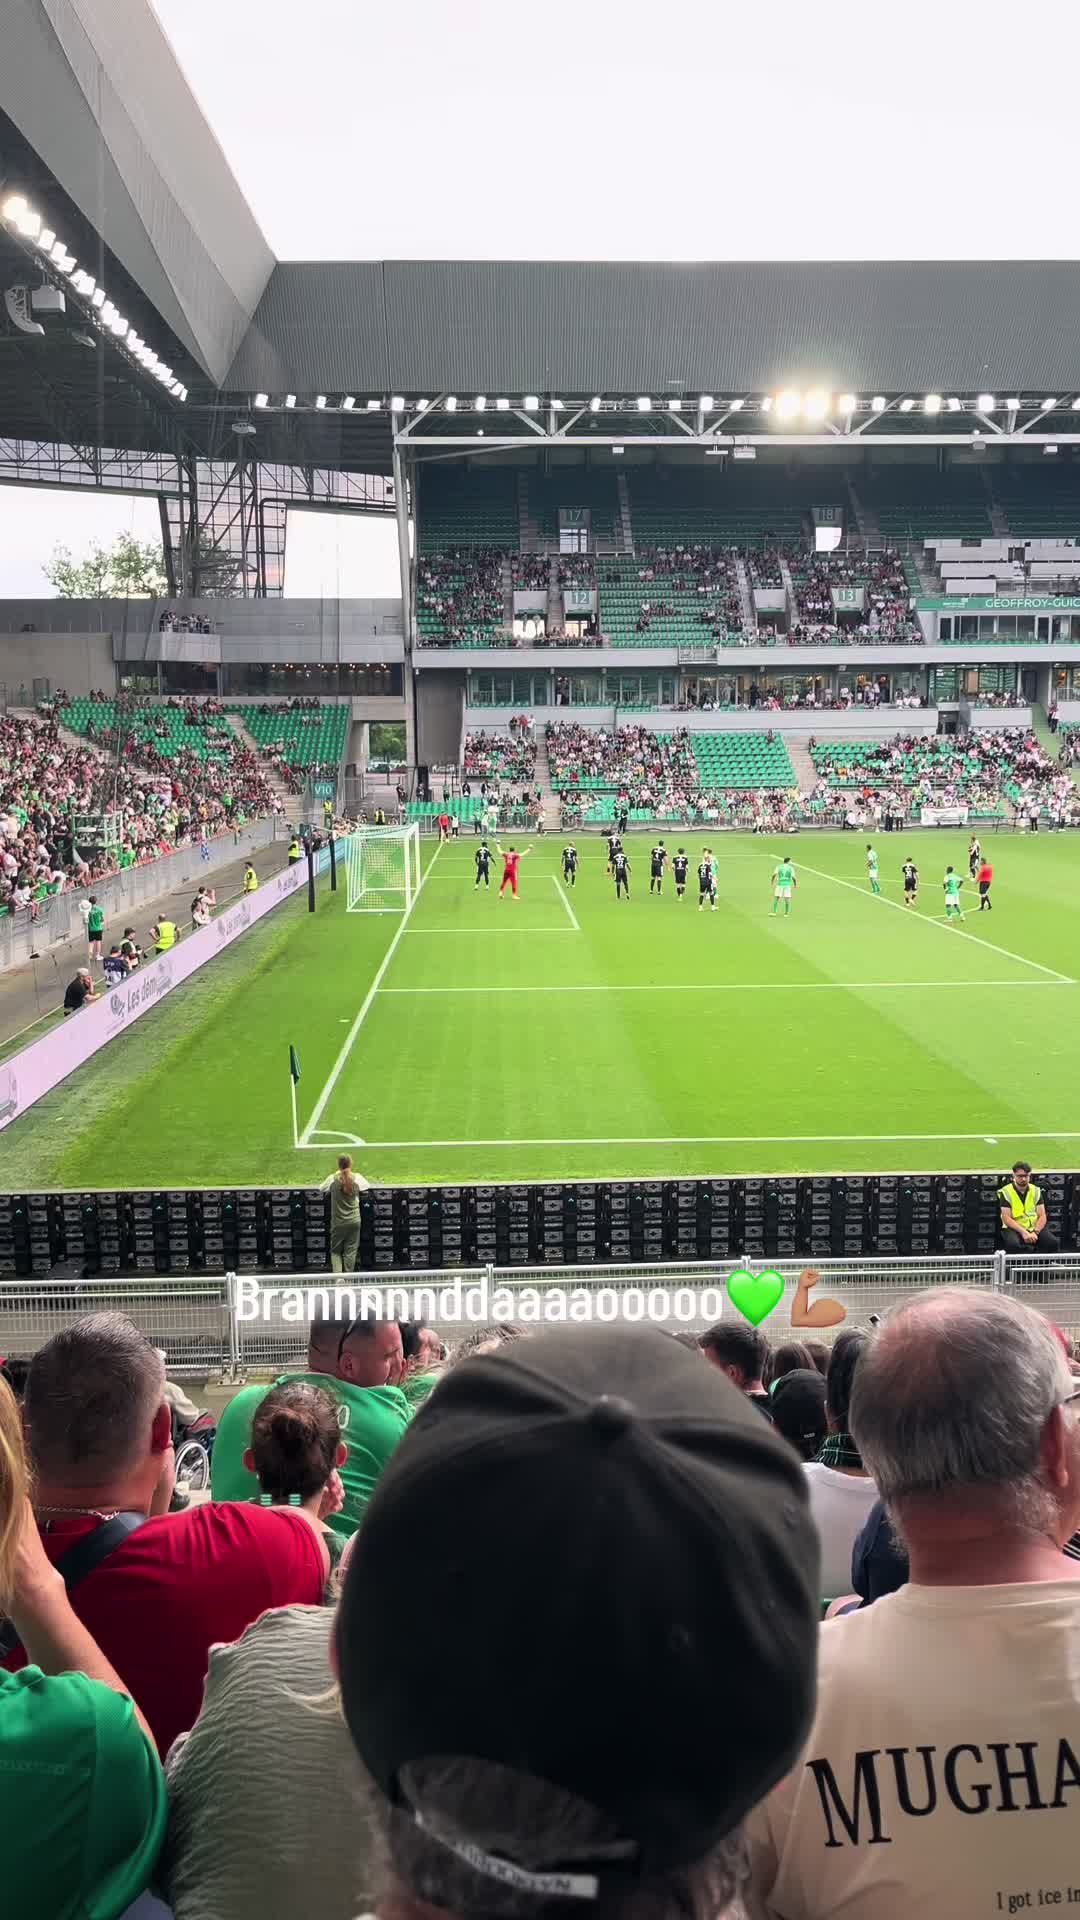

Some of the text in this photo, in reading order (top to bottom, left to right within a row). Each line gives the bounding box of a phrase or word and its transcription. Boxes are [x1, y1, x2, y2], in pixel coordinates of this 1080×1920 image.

[569, 509, 582, 521] 17
[822, 509, 833, 520] 18
[574, 591, 588, 604] 12
[841, 590, 854, 601] 13
[314, 784, 332, 794] V10
[1008, 1892, 1033, 1914] got
[1038, 1889, 1062, 1904] ice
